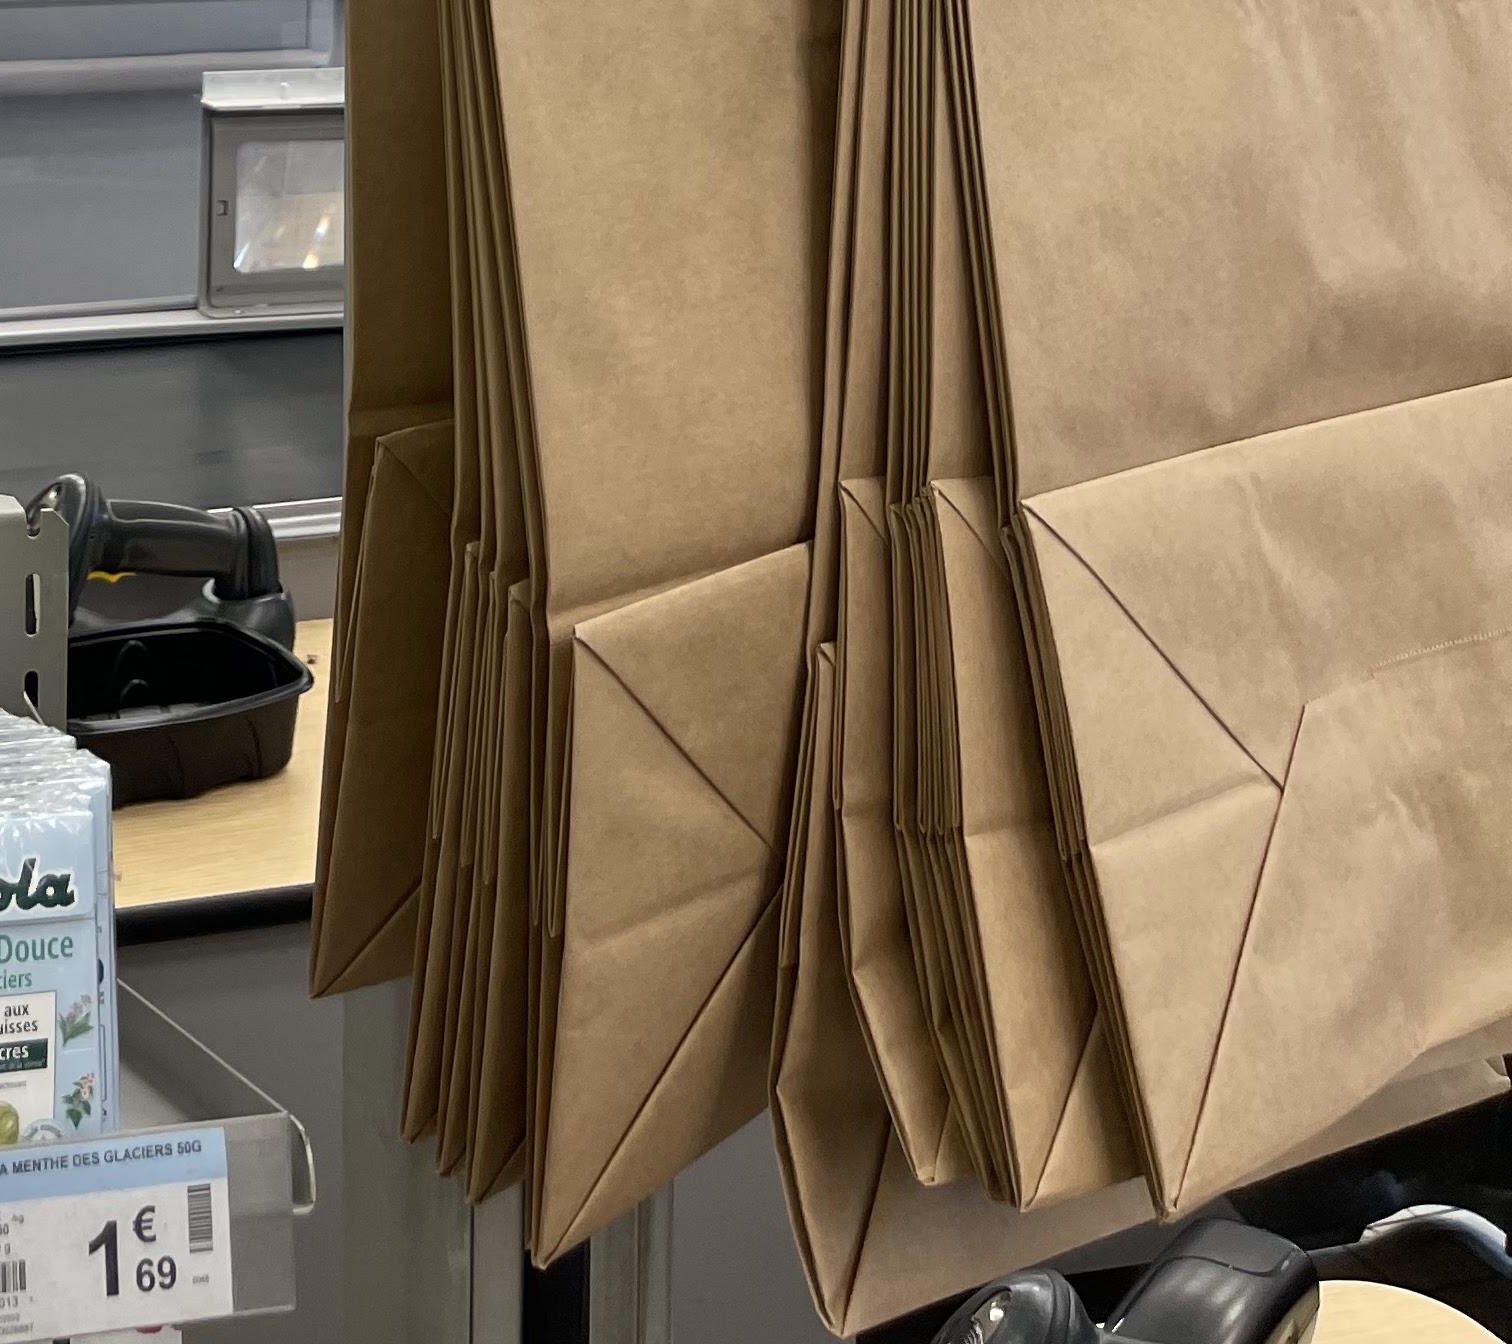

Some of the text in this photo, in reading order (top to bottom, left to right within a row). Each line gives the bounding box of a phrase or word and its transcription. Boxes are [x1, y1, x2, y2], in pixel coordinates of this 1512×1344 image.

[4, 1003, 29, 1016] aux
[12, 1155, 69, 1173] MENTHE
[73, 1152, 100, 1167] DES
[104, 1144, 173, 1163] GLACIERS
[177, 1139, 202, 1155] 50G
[88, 1205, 177, 1297] 1 € 69
